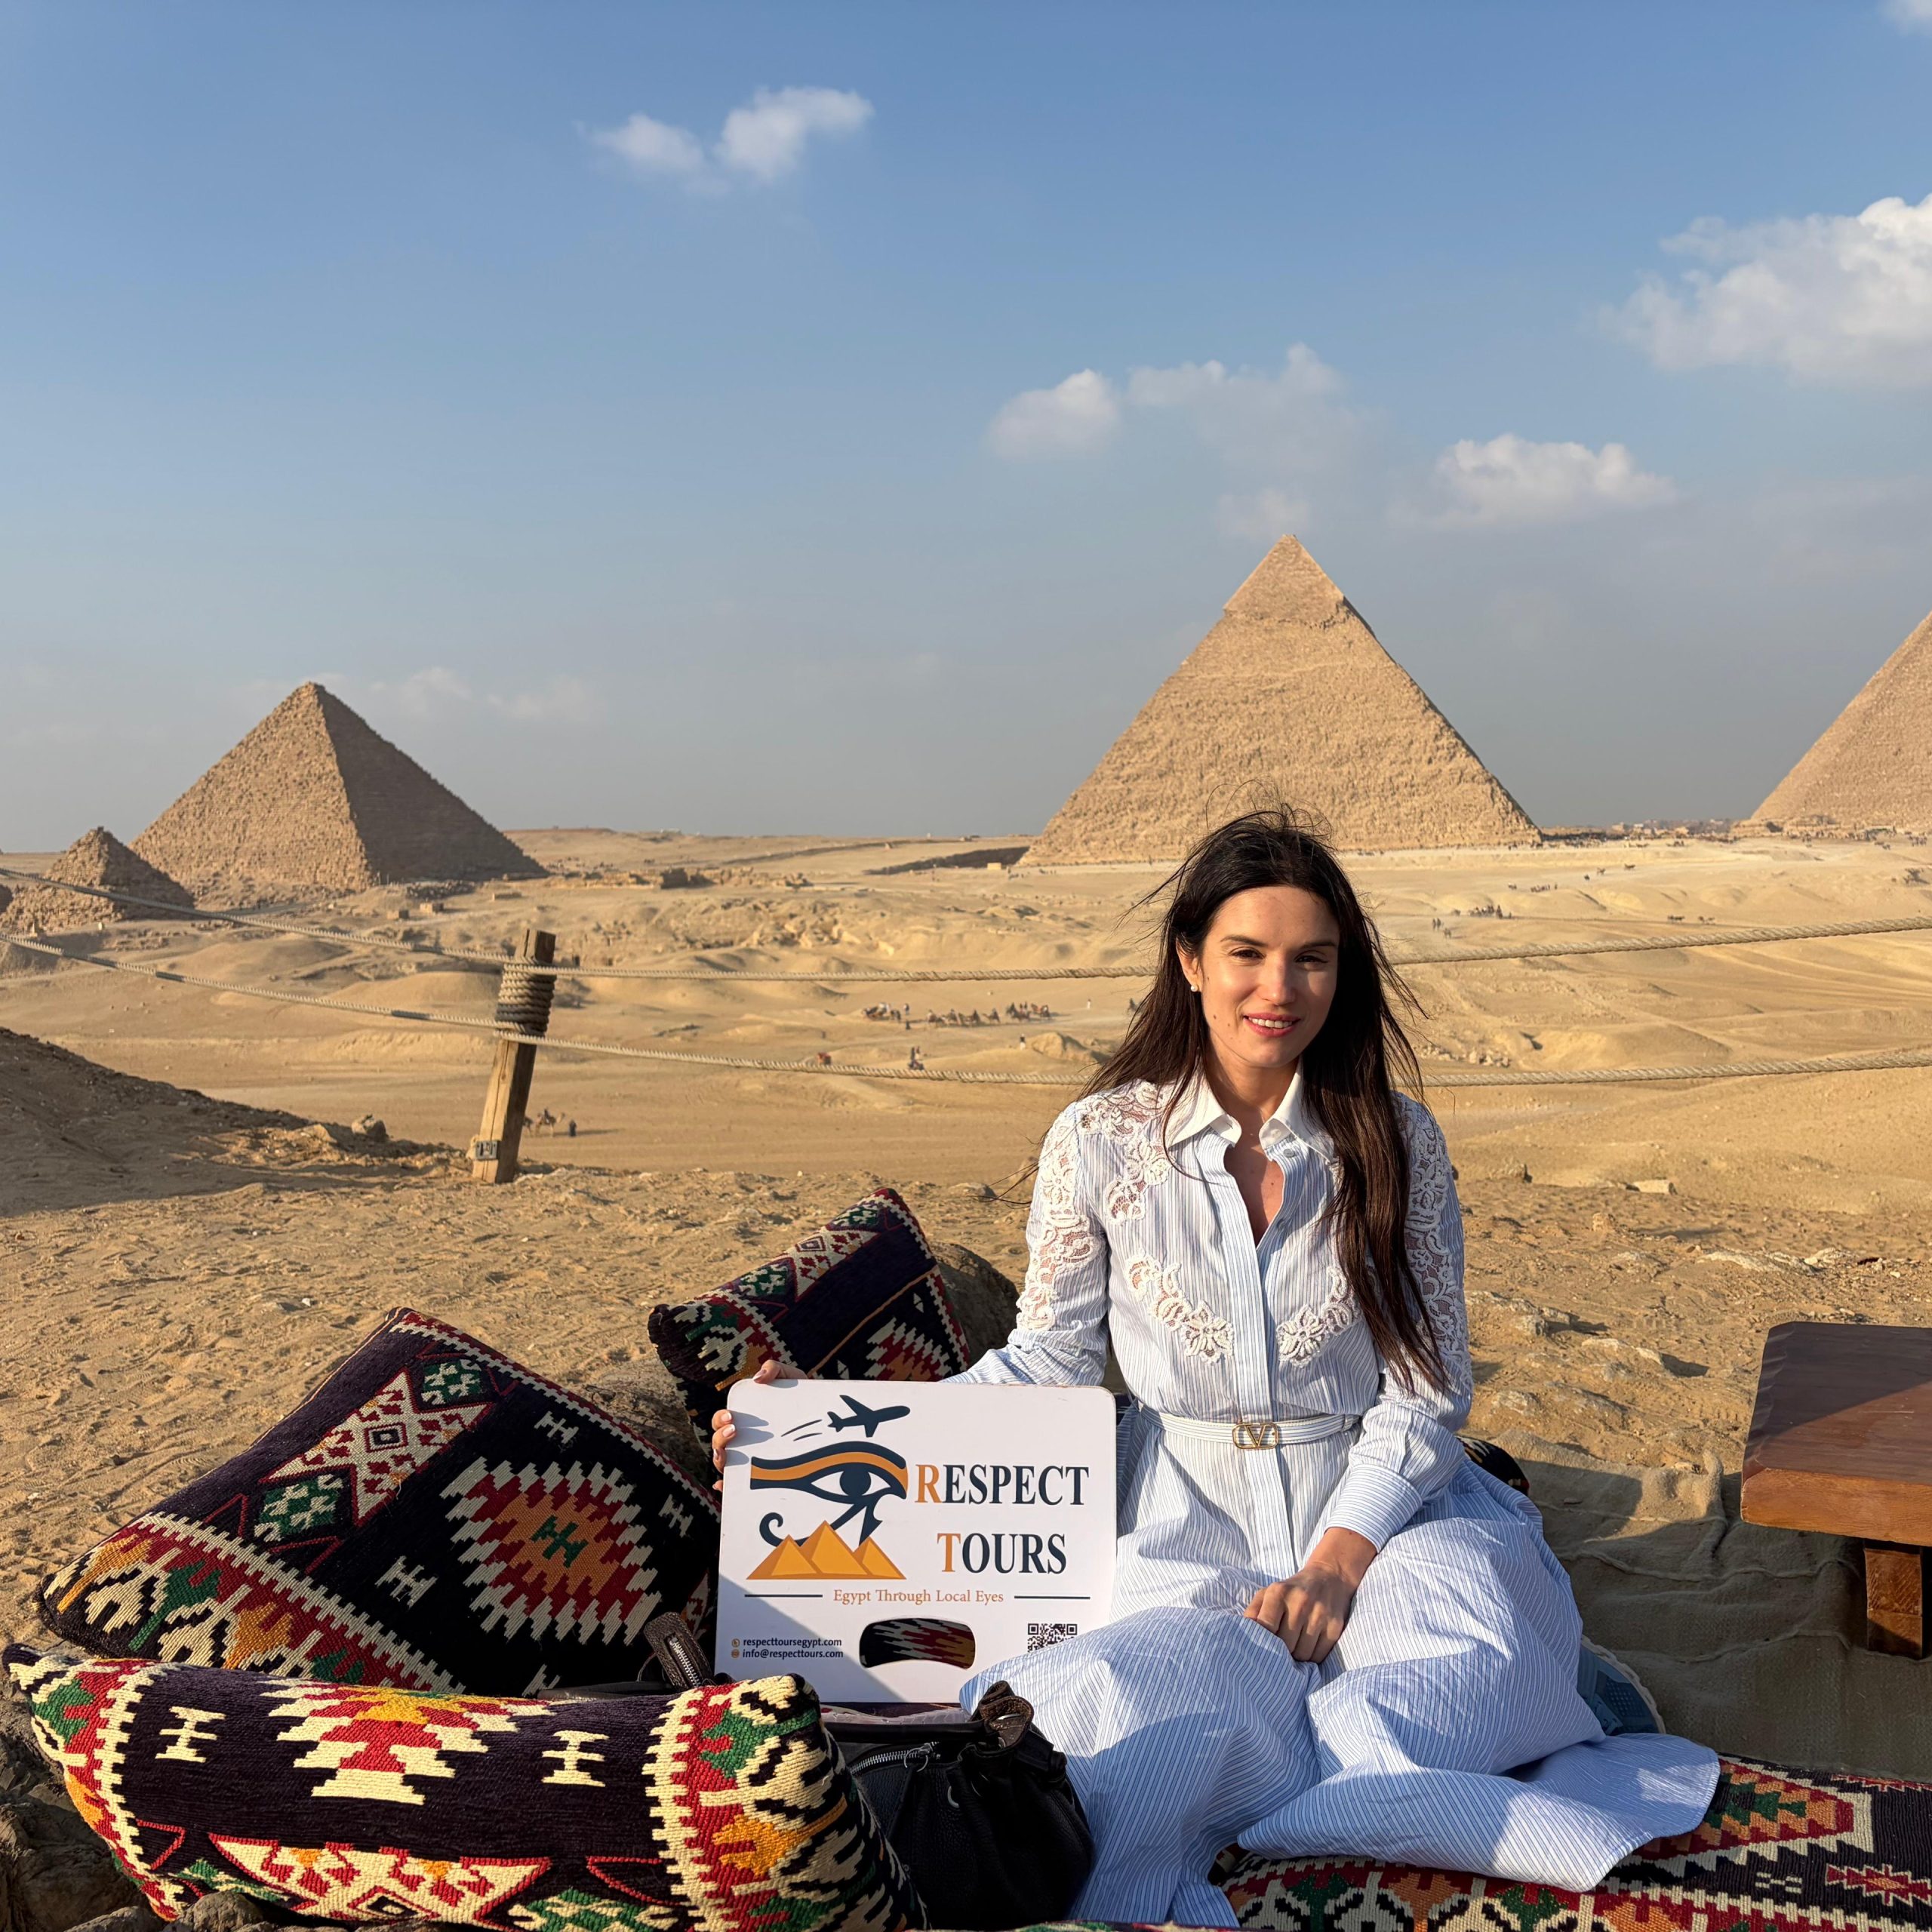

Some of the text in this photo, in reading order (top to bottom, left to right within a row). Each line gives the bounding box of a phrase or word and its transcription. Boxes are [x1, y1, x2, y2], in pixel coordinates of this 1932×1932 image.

[915, 1463, 1089, 1506] RESPECT
[937, 1533, 1067, 1575] TOURS
[833, 1589, 1004, 1605] Egypt Through Local Eyes
[743, 1638, 842, 1648] respecttoursegypt.com
[742, 1649, 844, 1660] info@respecttours.com
